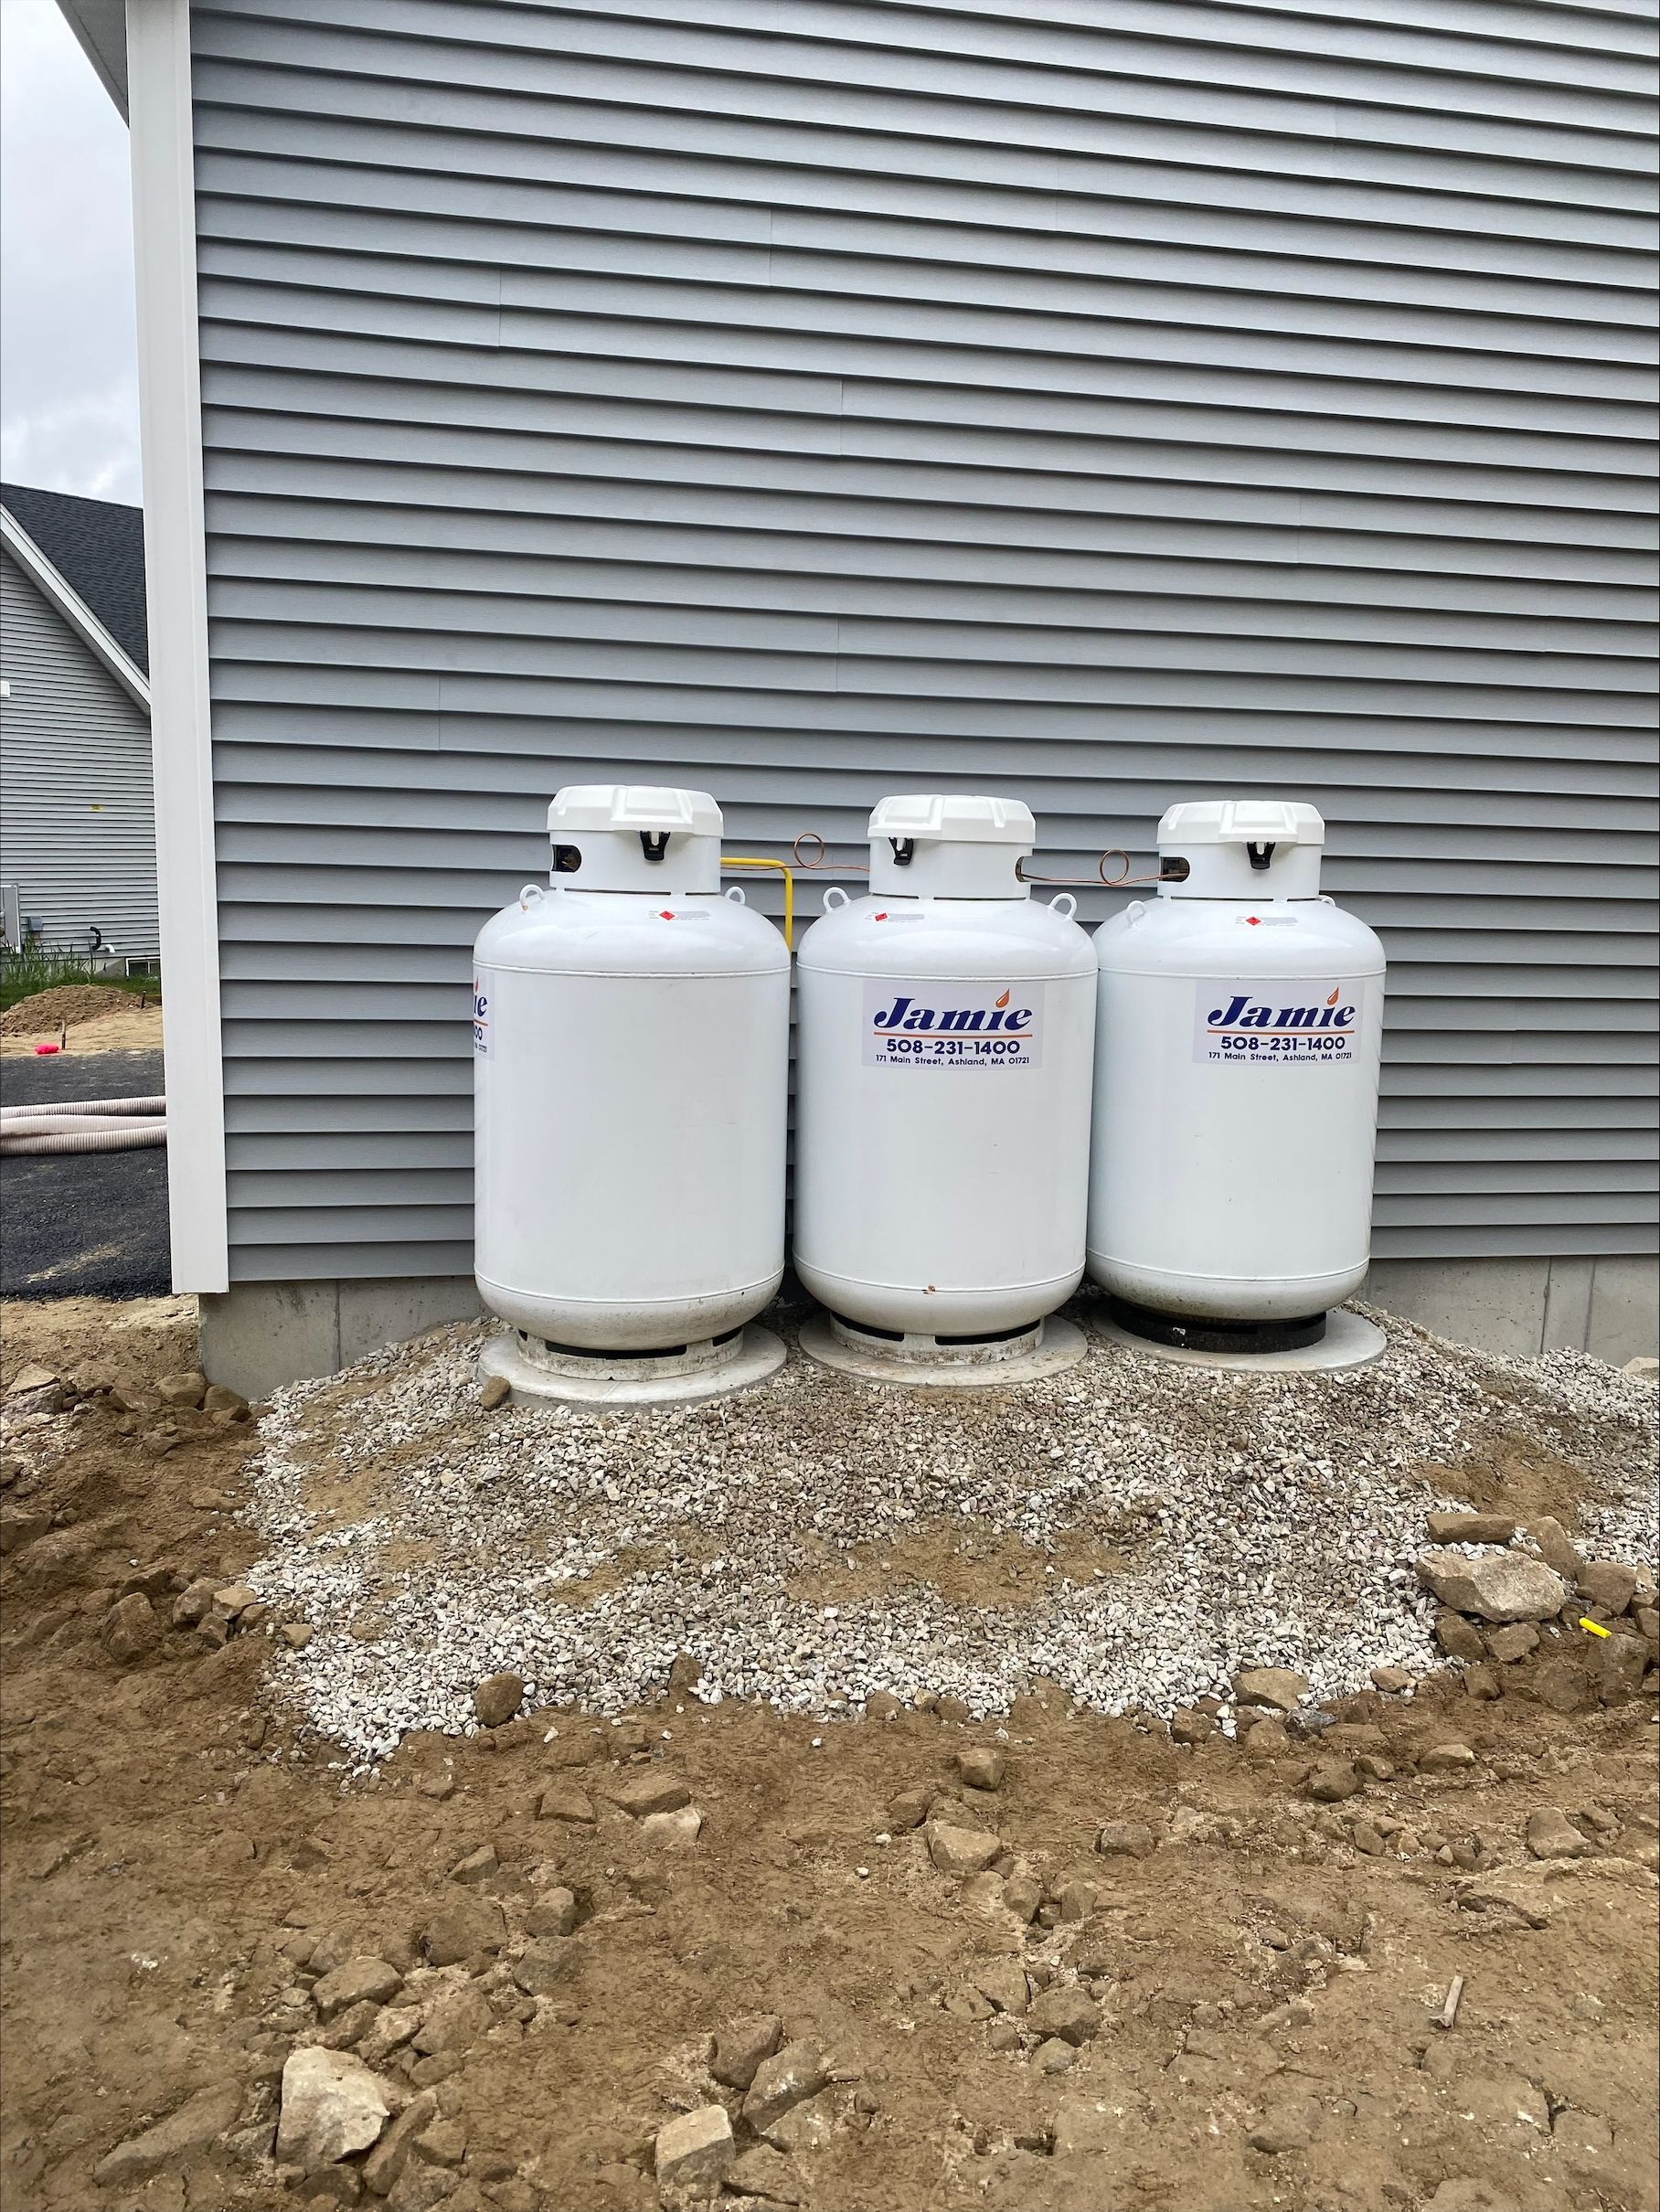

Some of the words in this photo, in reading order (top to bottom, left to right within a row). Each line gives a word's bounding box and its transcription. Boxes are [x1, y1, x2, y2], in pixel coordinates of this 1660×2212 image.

[874, 988, 1033, 1031] Jamie
[1208, 986, 1356, 1028] Jamie
[886, 1038, 1020, 1055] 508-231-1400
[1220, 1036, 1346, 1051] 508-231-1400
[876, 1054, 887, 1062] 171
[890, 1055, 910, 1064] Main
[915, 1057, 944, 1066] Street,
[948, 1058, 987, 1066] Ashland,
[1208, 1051, 1220, 1059] 171
[1224, 1052, 1246, 1060] Main
[1250, 1053, 1279, 1062] Street,
[1282, 1053, 1318, 1062] Ashland,
